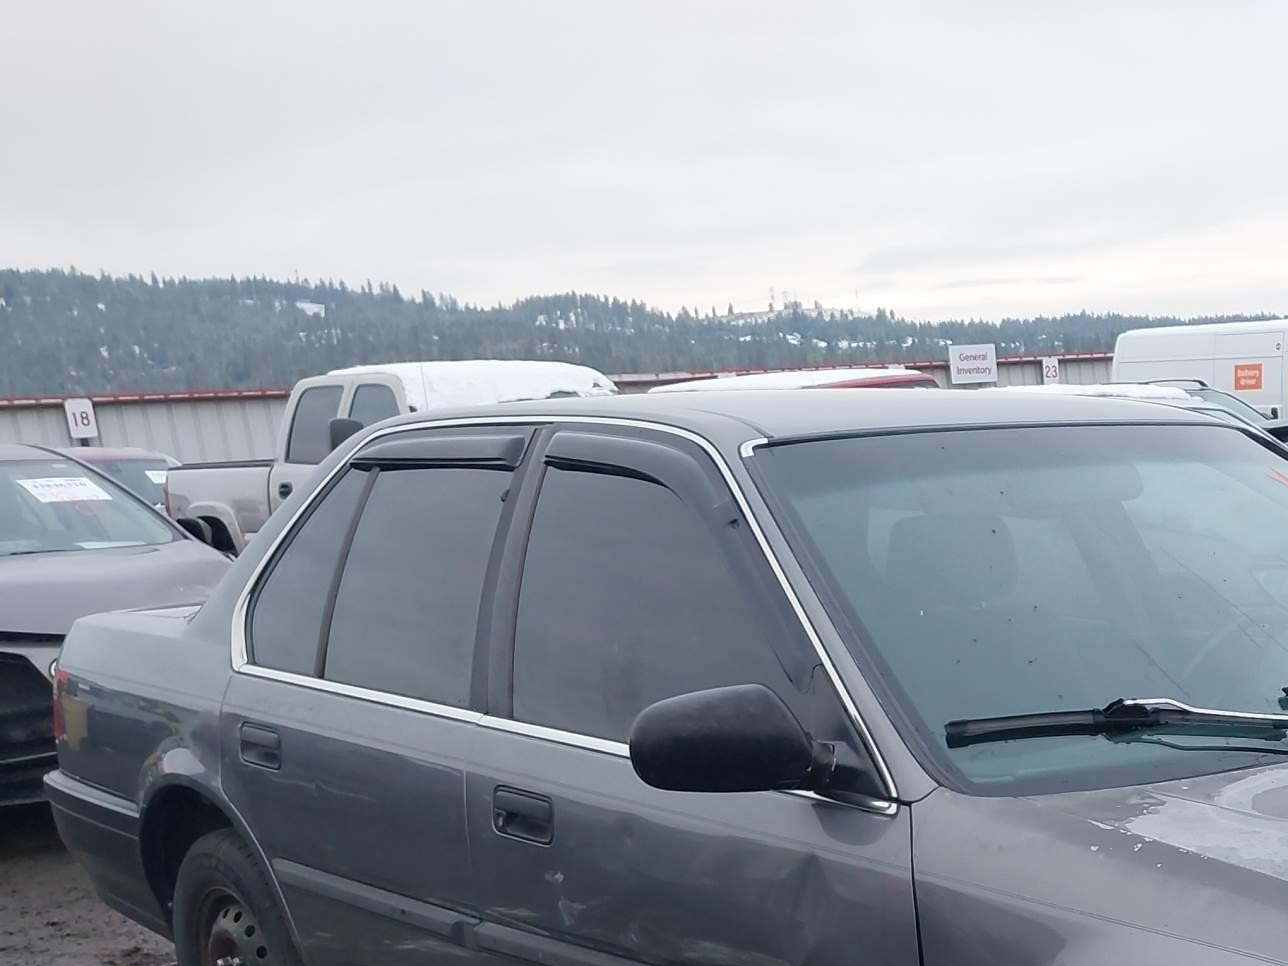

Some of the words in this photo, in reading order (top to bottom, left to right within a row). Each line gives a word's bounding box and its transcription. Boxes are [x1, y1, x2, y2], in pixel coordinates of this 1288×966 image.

[959, 352, 988, 361] General
[957, 366, 992, 376] Inventory
[1045, 365, 1059, 378] 23
[72, 411, 90, 427] 18
